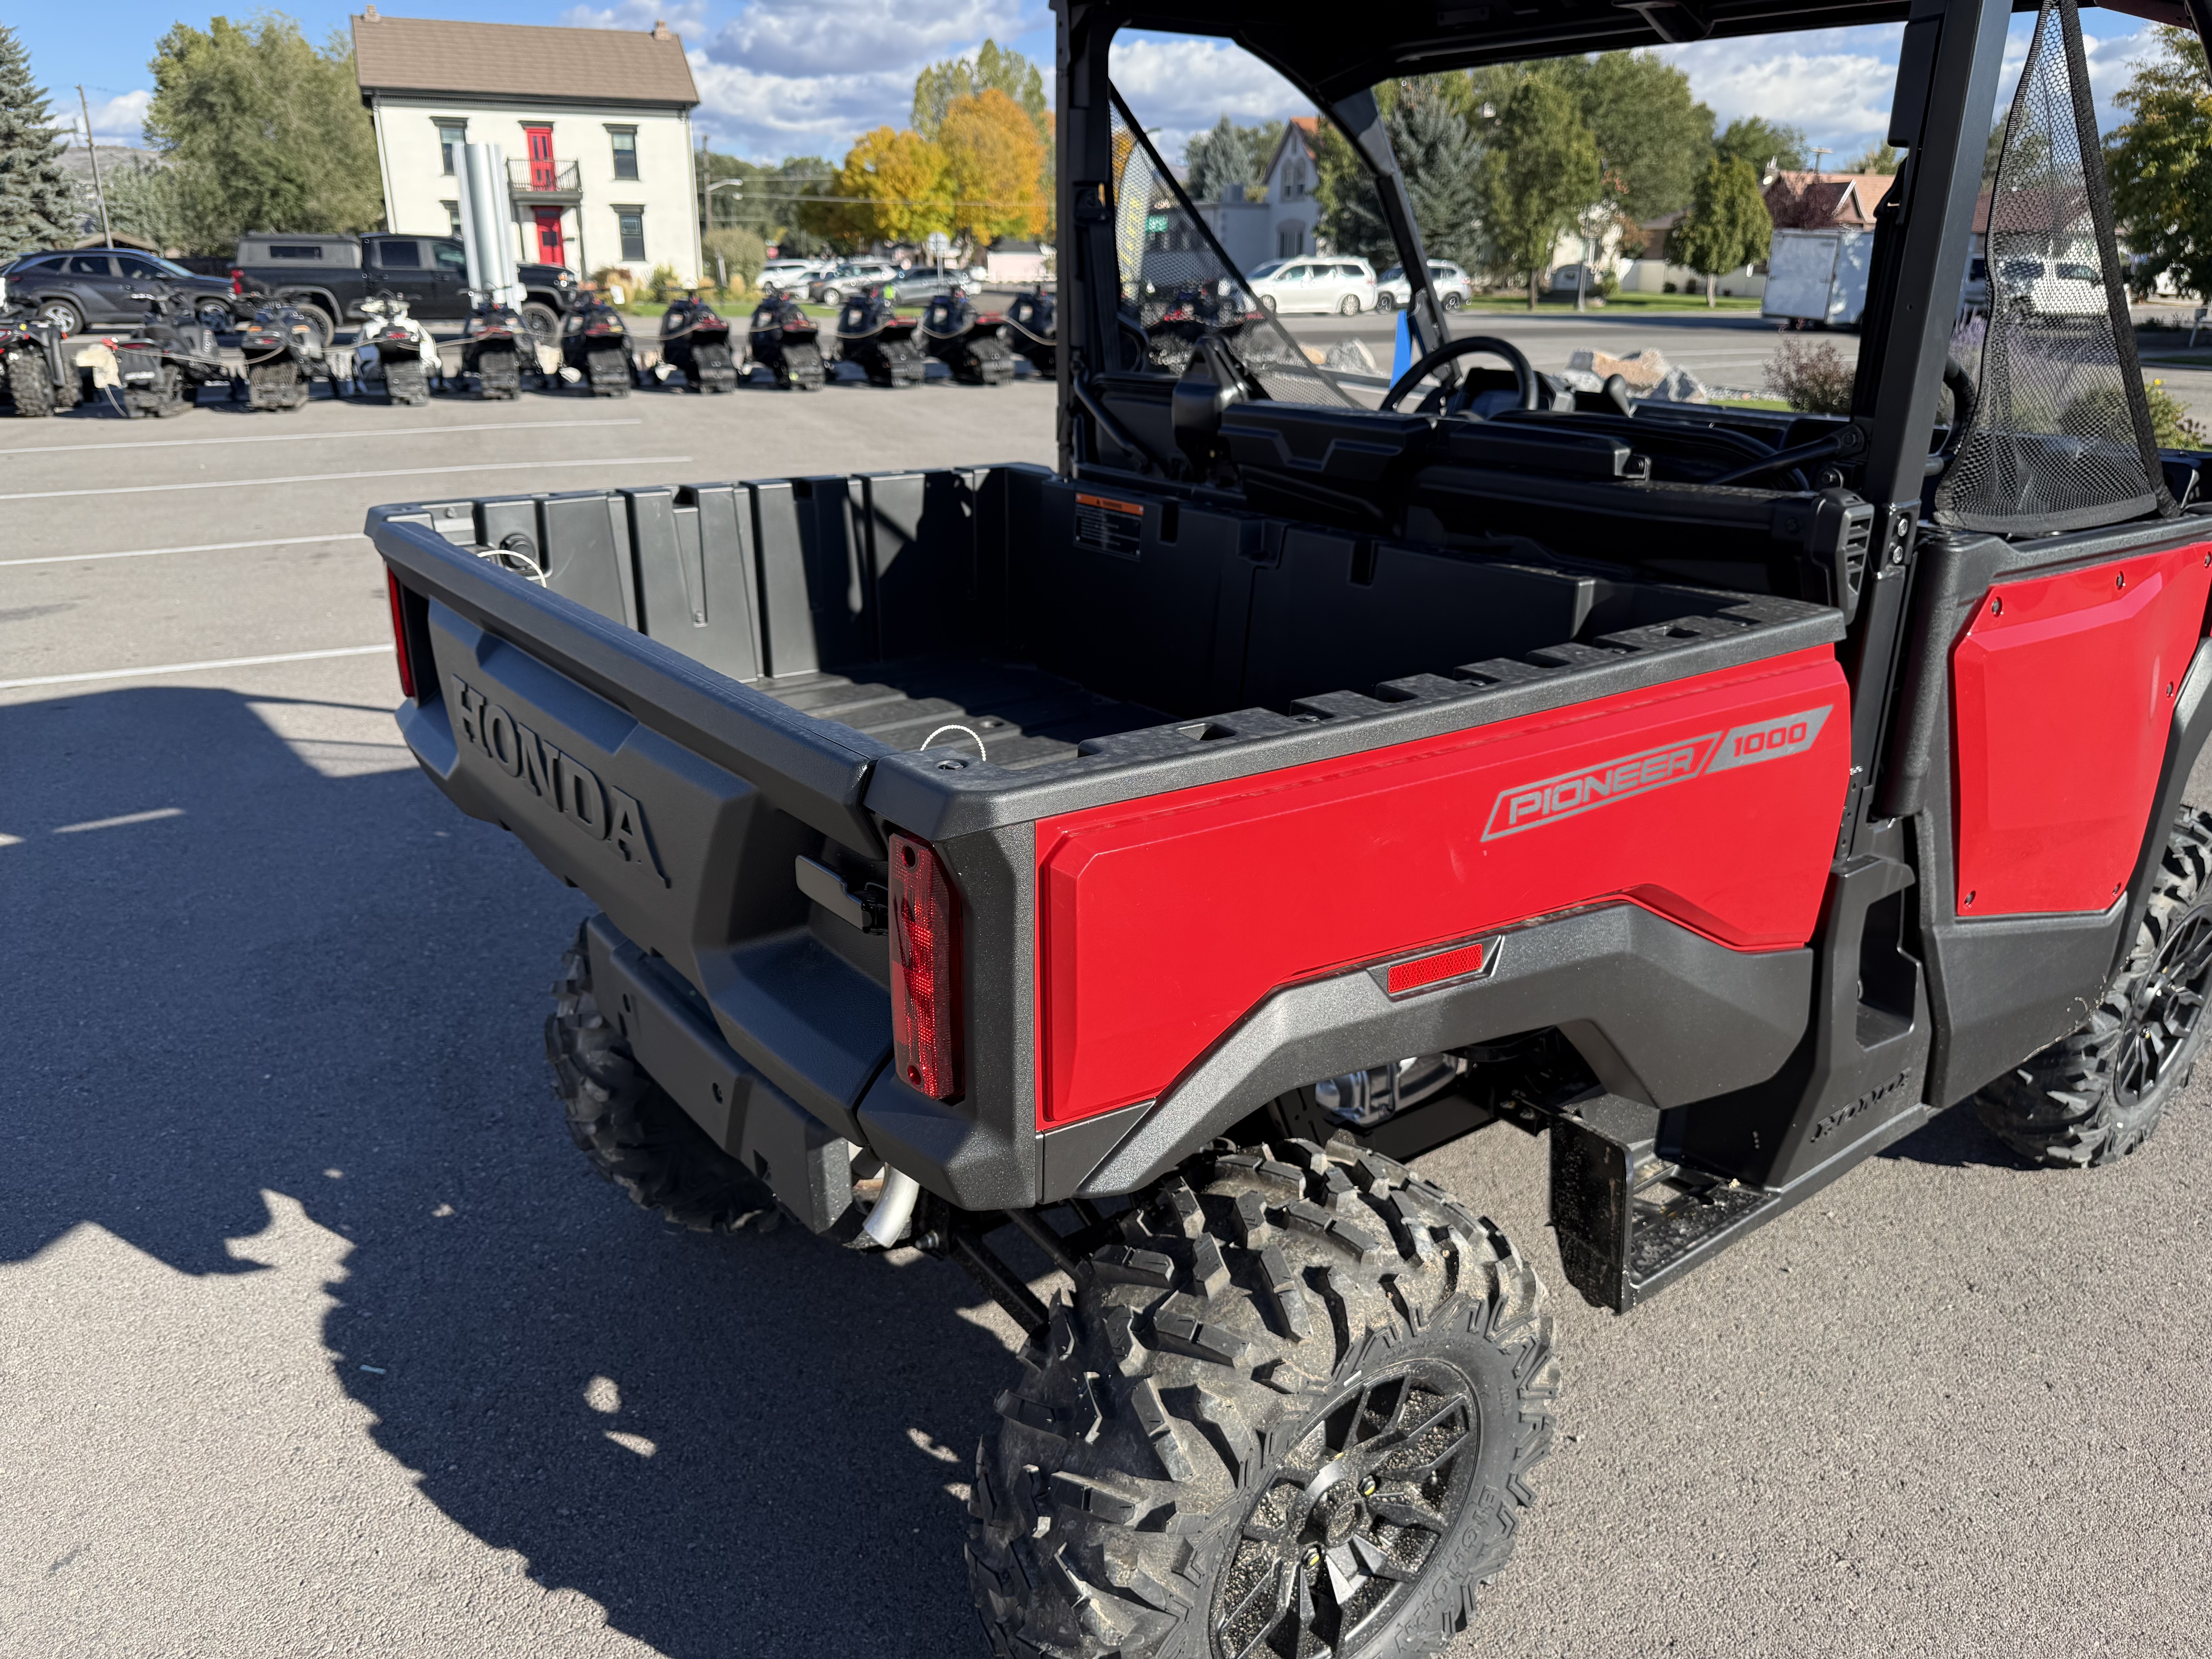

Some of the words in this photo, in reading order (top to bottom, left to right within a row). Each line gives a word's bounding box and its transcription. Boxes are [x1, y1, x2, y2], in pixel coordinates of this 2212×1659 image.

[451, 673, 671, 889] HONDA
[1509, 747, 1695, 825] PIONEER
[1733, 723, 1807, 758] 1000
